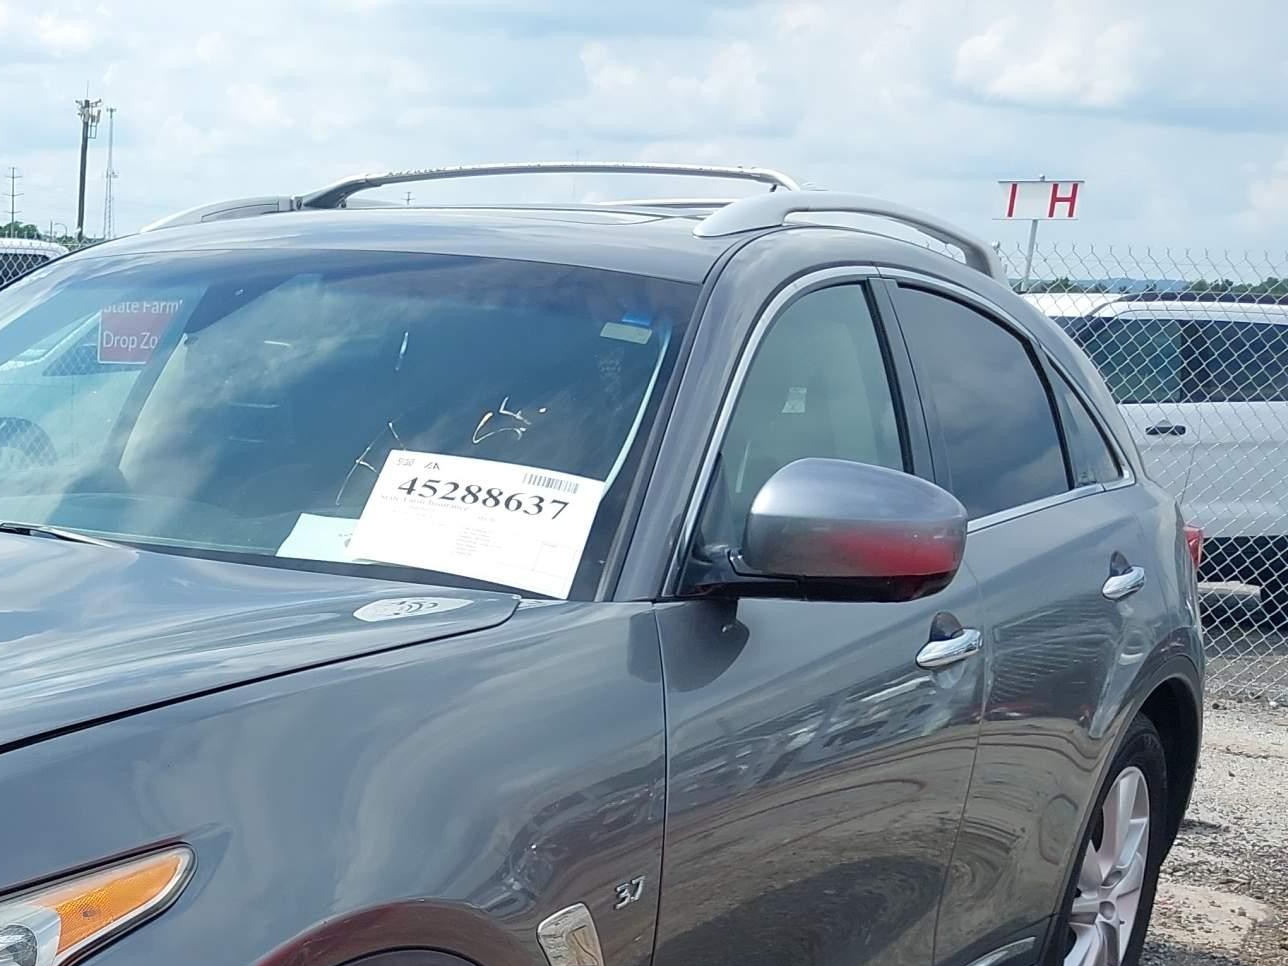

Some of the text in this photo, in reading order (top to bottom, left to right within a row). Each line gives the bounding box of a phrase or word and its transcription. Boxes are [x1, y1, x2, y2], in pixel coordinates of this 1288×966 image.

[1048, 183, 1079, 218] H
[103, 331, 160, 351] Drop Zo
[398, 477, 569, 520] 45288637
